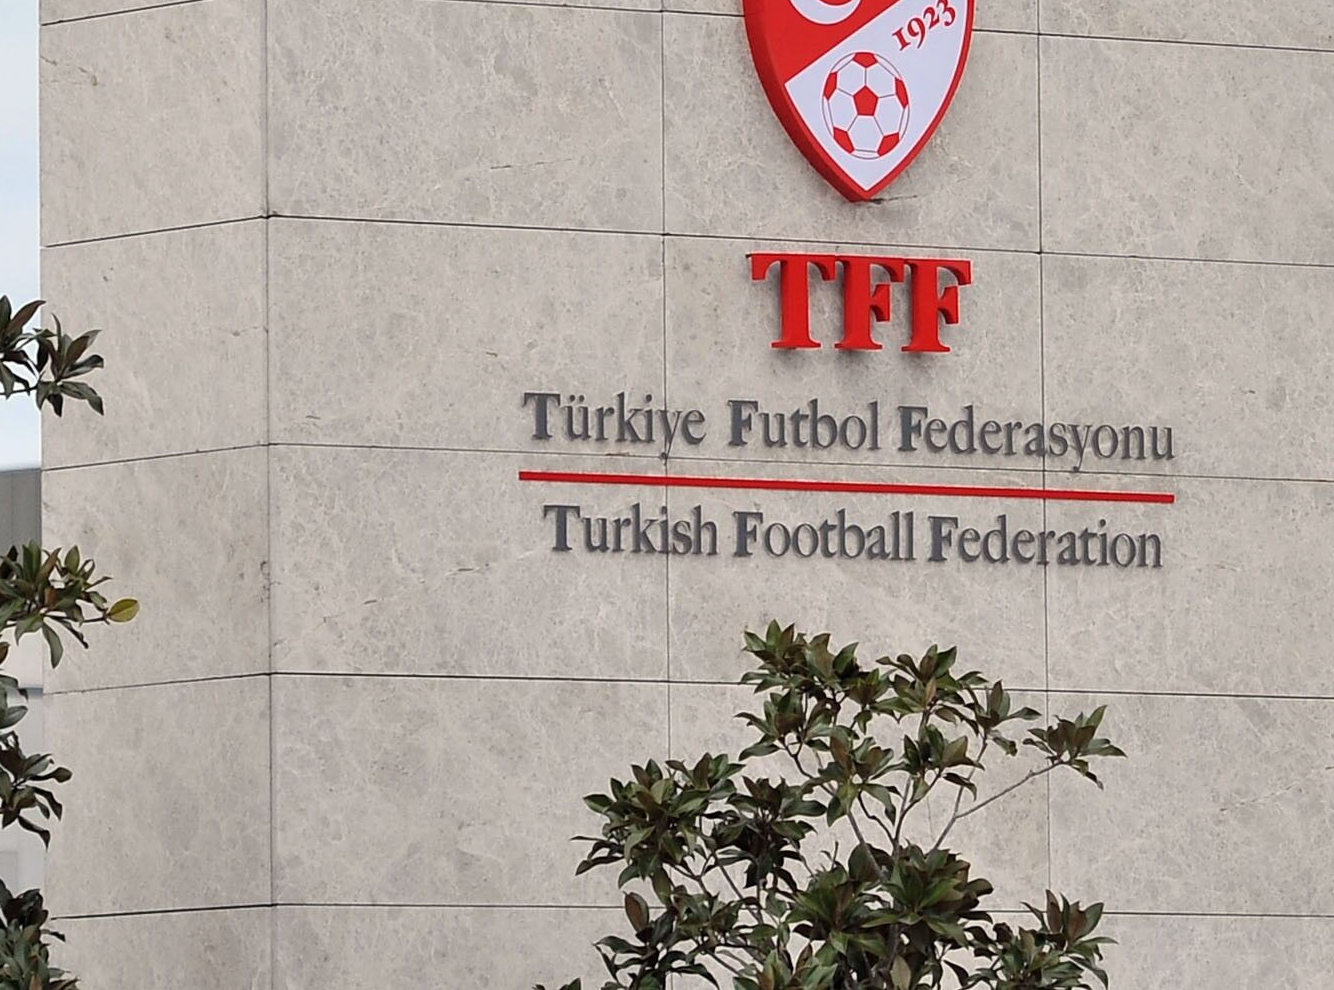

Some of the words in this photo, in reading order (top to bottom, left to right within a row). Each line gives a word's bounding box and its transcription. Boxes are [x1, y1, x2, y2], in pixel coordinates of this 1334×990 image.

[746, 253, 972, 354] TFF
[522, 392, 707, 460] Türkiye
[727, 398, 881, 450] Futbol
[897, 404, 1175, 473] Federasyonu
[542, 502, 718, 557] Turkish
[732, 508, 917, 561] Football
[927, 514, 1164, 569] Federation
